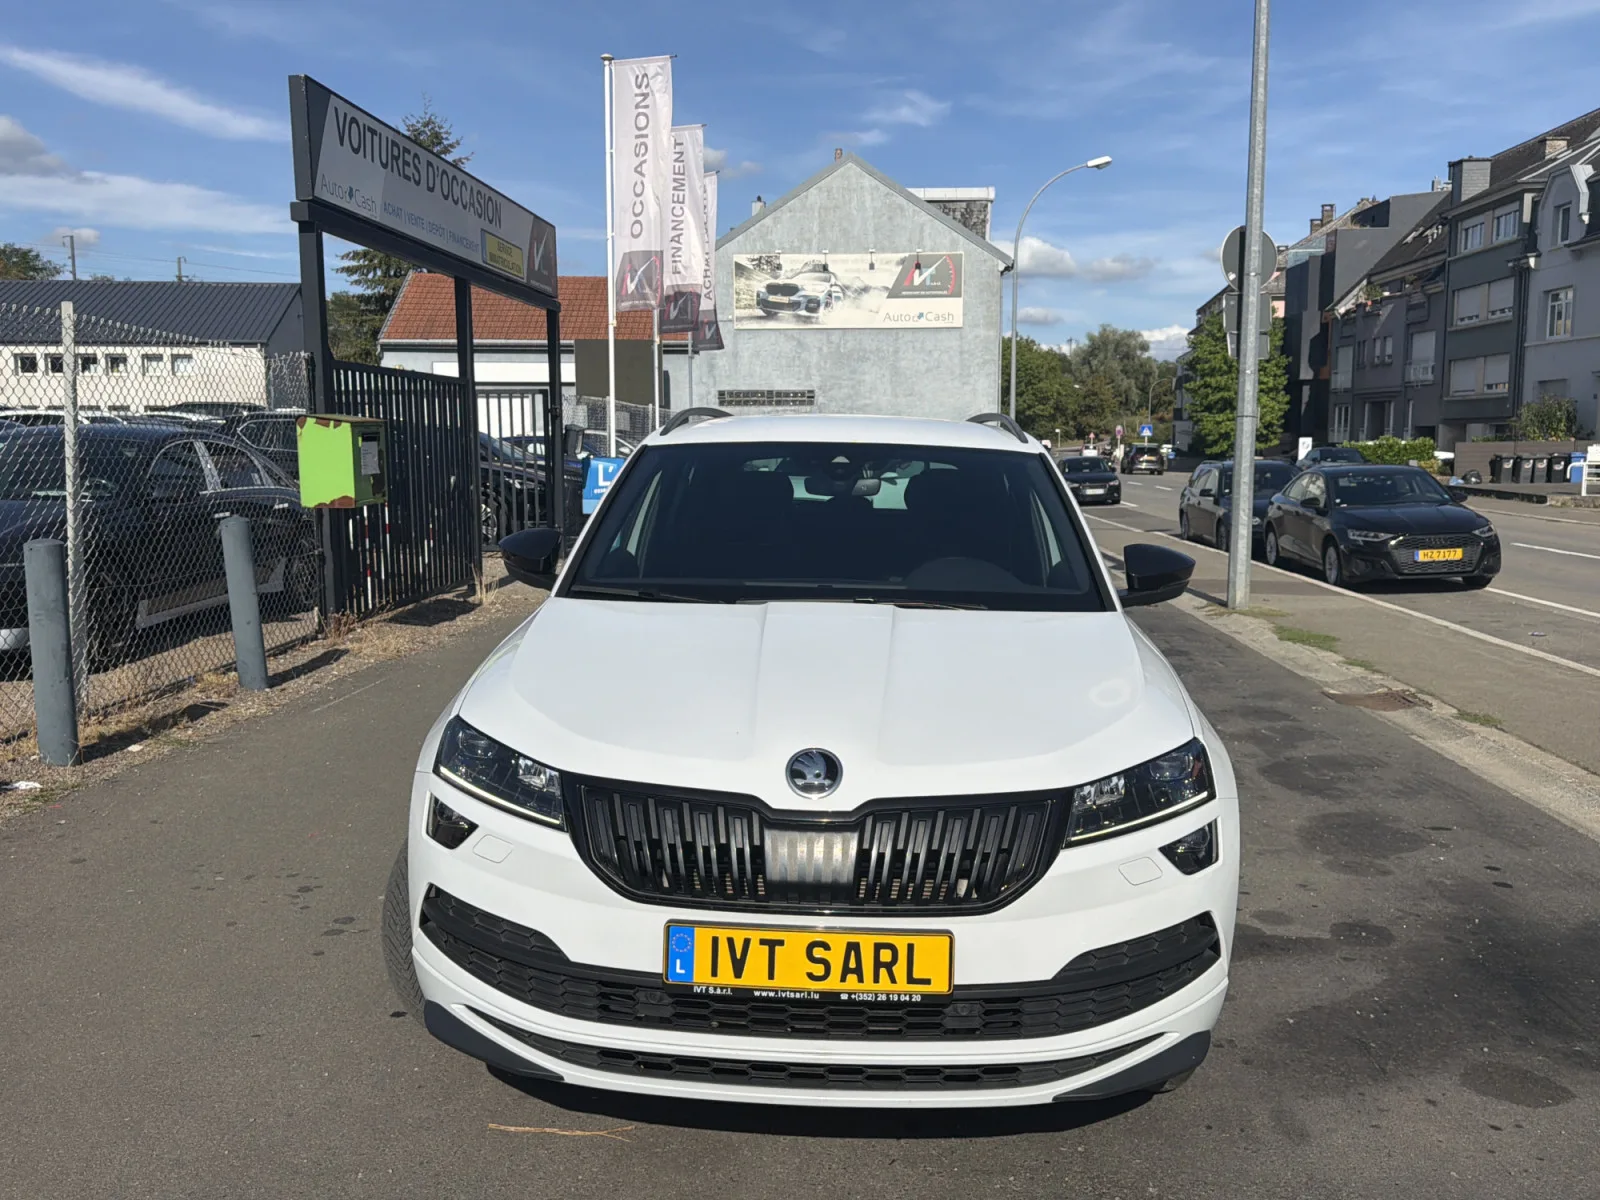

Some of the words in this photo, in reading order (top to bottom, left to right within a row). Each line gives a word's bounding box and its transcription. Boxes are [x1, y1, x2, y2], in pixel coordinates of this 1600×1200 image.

[334, 106, 421, 187] VOITURES
[426, 160, 502, 229] D'OCCASION
[630, 72, 650, 239] OCCASIONS
[321, 173, 344, 199] Auto
[354, 189, 377, 214] Cash
[671, 138, 686, 275] FINANCEMENT
[383, 202, 403, 221] ACHAT
[406, 210, 425, 229] VENTE
[883, 312, 911, 322] Auto
[925, 311, 954, 322] Cash
[675, 959, 686, 974] L
[710, 935, 785, 981] IVT
[805, 940, 932, 986] SARL
[693, 986, 706, 994] IVT
[753, 990, 820, 999] www.ivtsarl.lu
[899, 994, 910, 1002] 04
[911, 994, 921, 1002] 20
